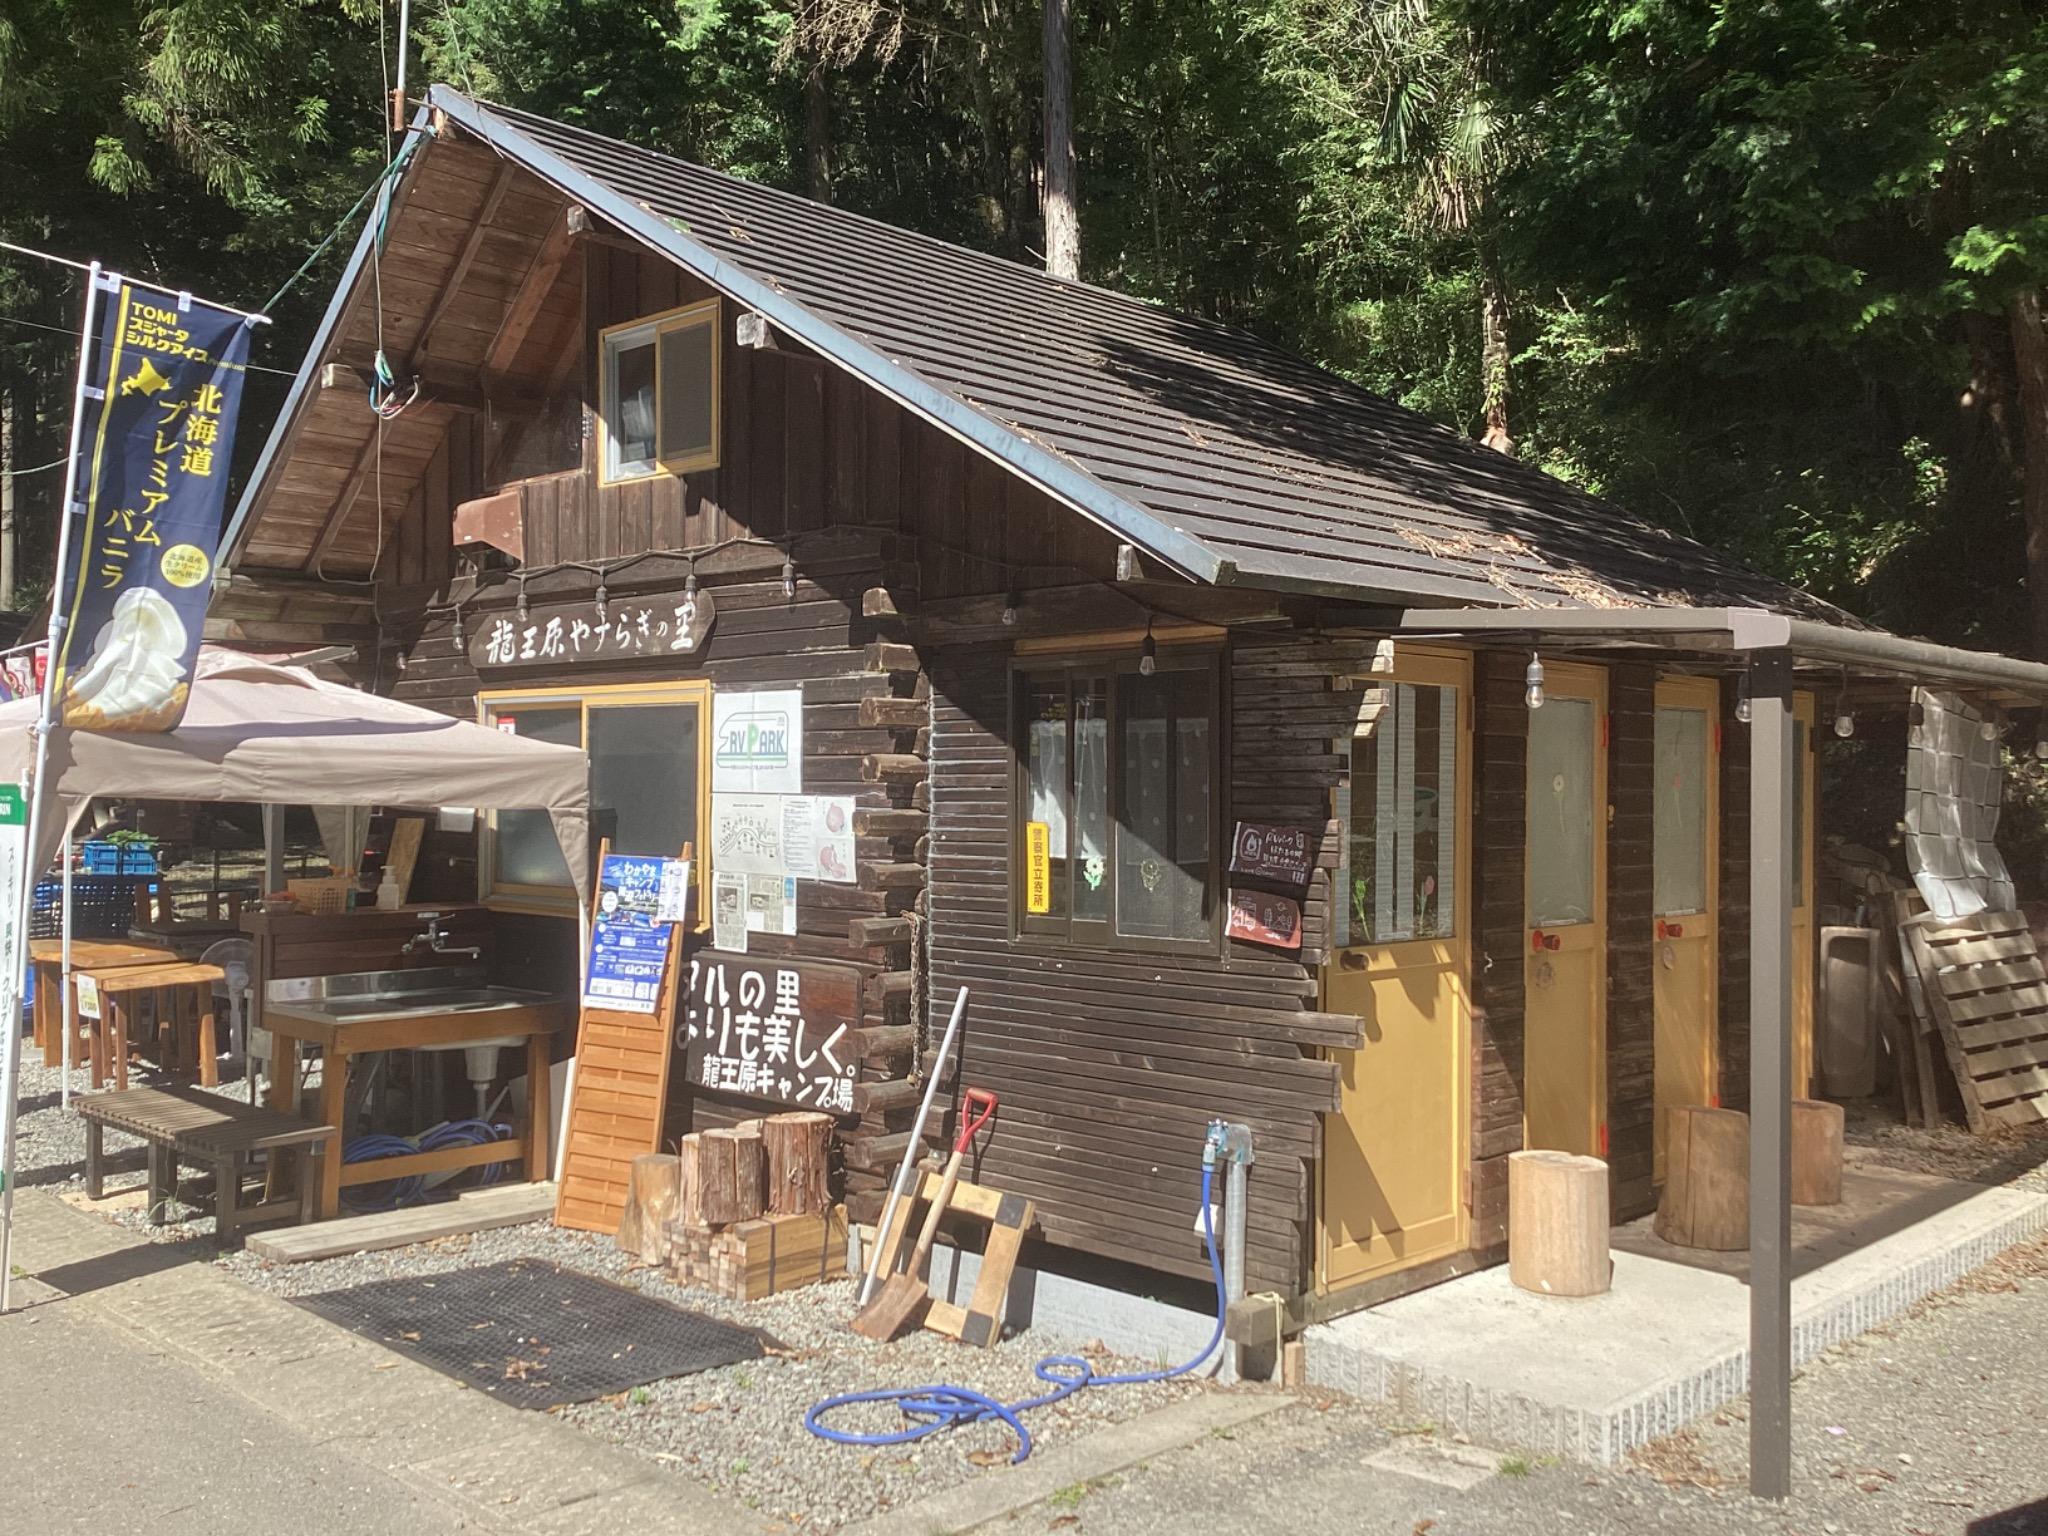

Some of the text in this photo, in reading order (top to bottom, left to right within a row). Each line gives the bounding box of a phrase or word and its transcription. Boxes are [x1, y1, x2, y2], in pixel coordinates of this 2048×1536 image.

[128, 316, 190, 342] スジャータ
[131, 302, 178, 326] TOMI
[126, 330, 208, 362] シルクアイス
[180, 384, 223, 476] 北海道
[134, 400, 188, 547] プレミアム
[101, 508, 136, 589] バニラ
[701, 1053, 854, 1113] 龍王原キャンプ場
